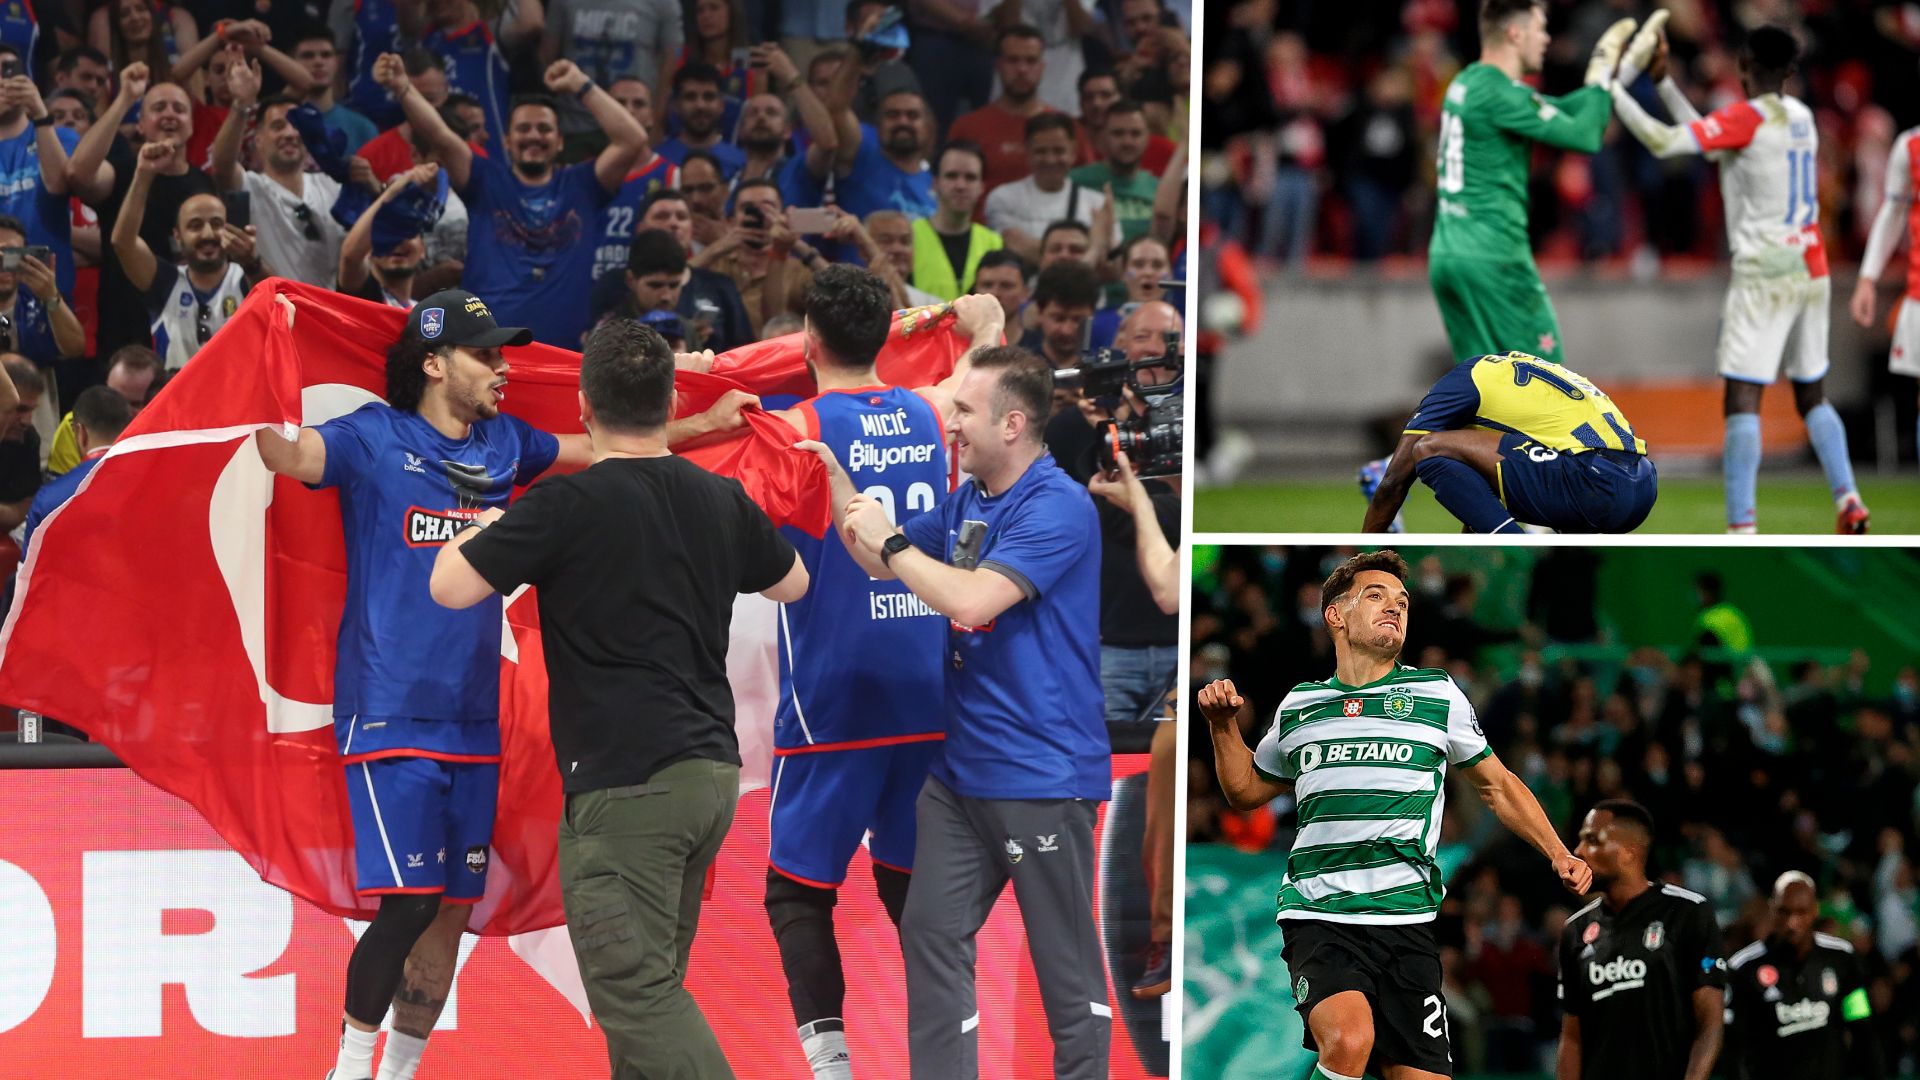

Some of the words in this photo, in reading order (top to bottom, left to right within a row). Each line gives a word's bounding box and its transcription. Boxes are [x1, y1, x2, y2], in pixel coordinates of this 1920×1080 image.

[605, 206, 634, 237] 22
[860, 407, 911, 436] MICIĆ
[849, 439, 936, 473] Bilyoner
[447, 510, 463, 519] BACK
[1326, 743, 1413, 762] BETANO
[1589, 955, 1647, 985] beko
